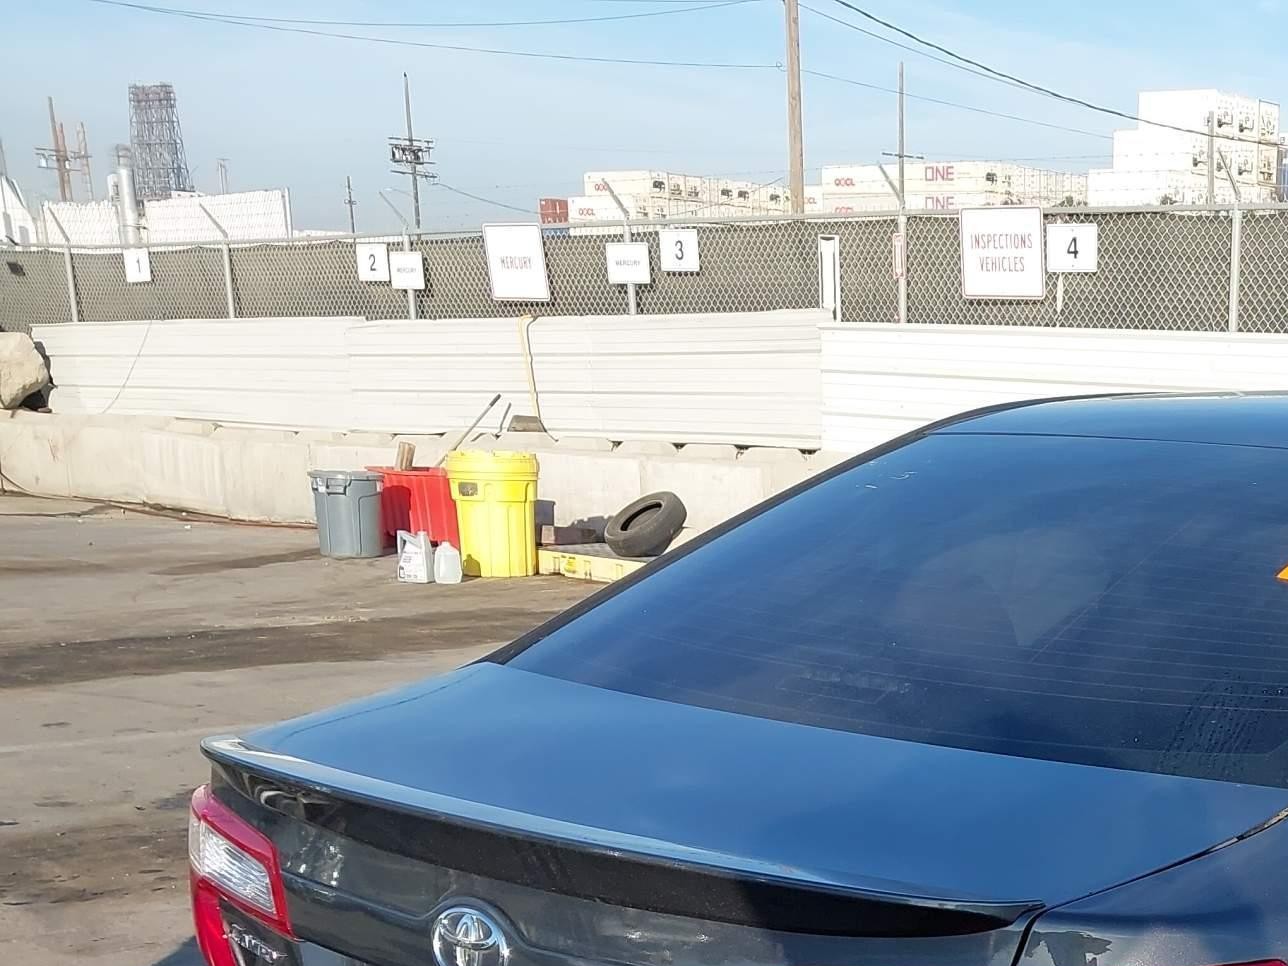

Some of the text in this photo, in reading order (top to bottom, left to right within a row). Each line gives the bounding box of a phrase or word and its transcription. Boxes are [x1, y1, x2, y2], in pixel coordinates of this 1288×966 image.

[924, 165, 955, 181] ONE
[674, 239, 685, 261] 3
[970, 232, 1033, 250] INSPECTIONS
[1066, 236, 1079, 259] 4
[368, 253, 377, 272] 2
[500, 255, 532, 270] MERCURY
[979, 255, 1025, 273] VEHICLES
